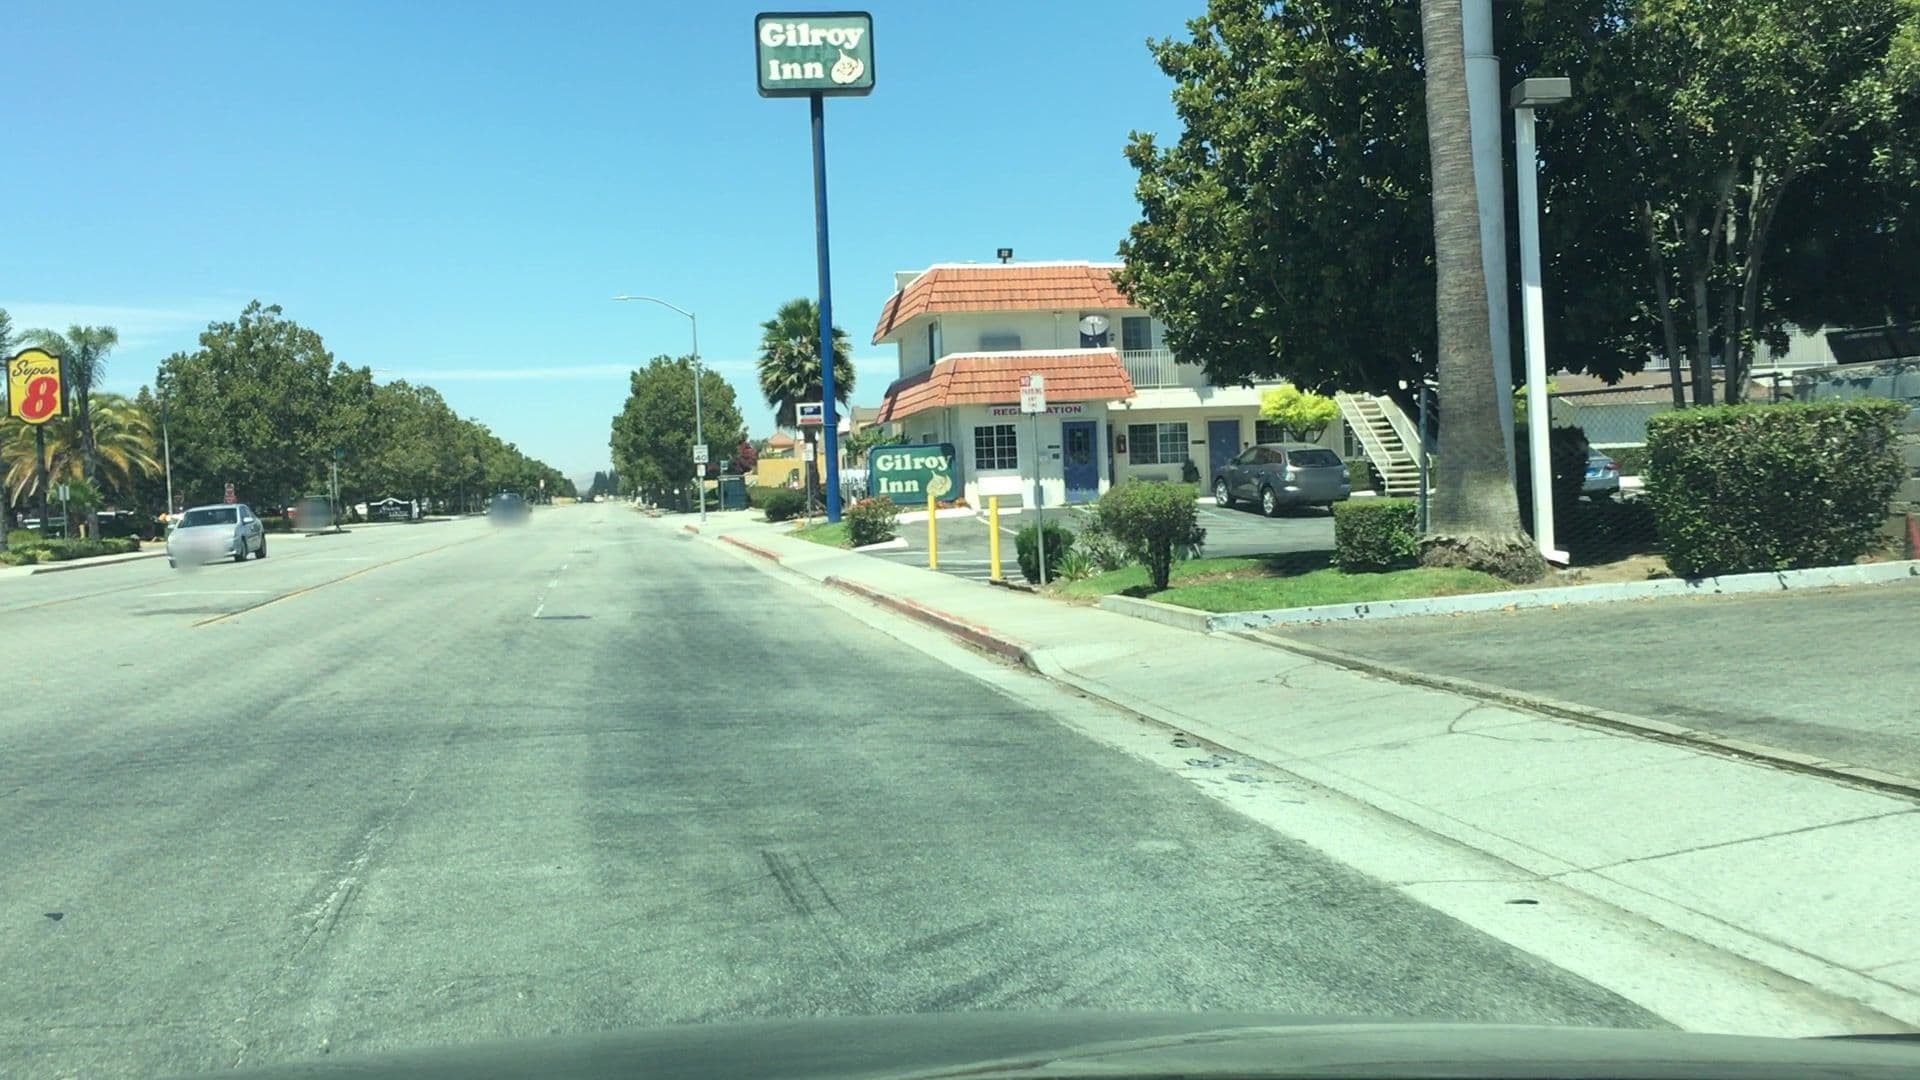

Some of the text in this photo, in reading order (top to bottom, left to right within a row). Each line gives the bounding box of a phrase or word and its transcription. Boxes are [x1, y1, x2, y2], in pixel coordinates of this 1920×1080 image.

[760, 23, 864, 50] Gilroy
[768, 59, 824, 80] Inn
[12, 360, 56, 384] Super
[21, 376, 58, 419] 8
[993, 405, 1082, 416] REGIATION
[876, 453, 953, 471] Gilroy
[879, 477, 919, 493] Inn
